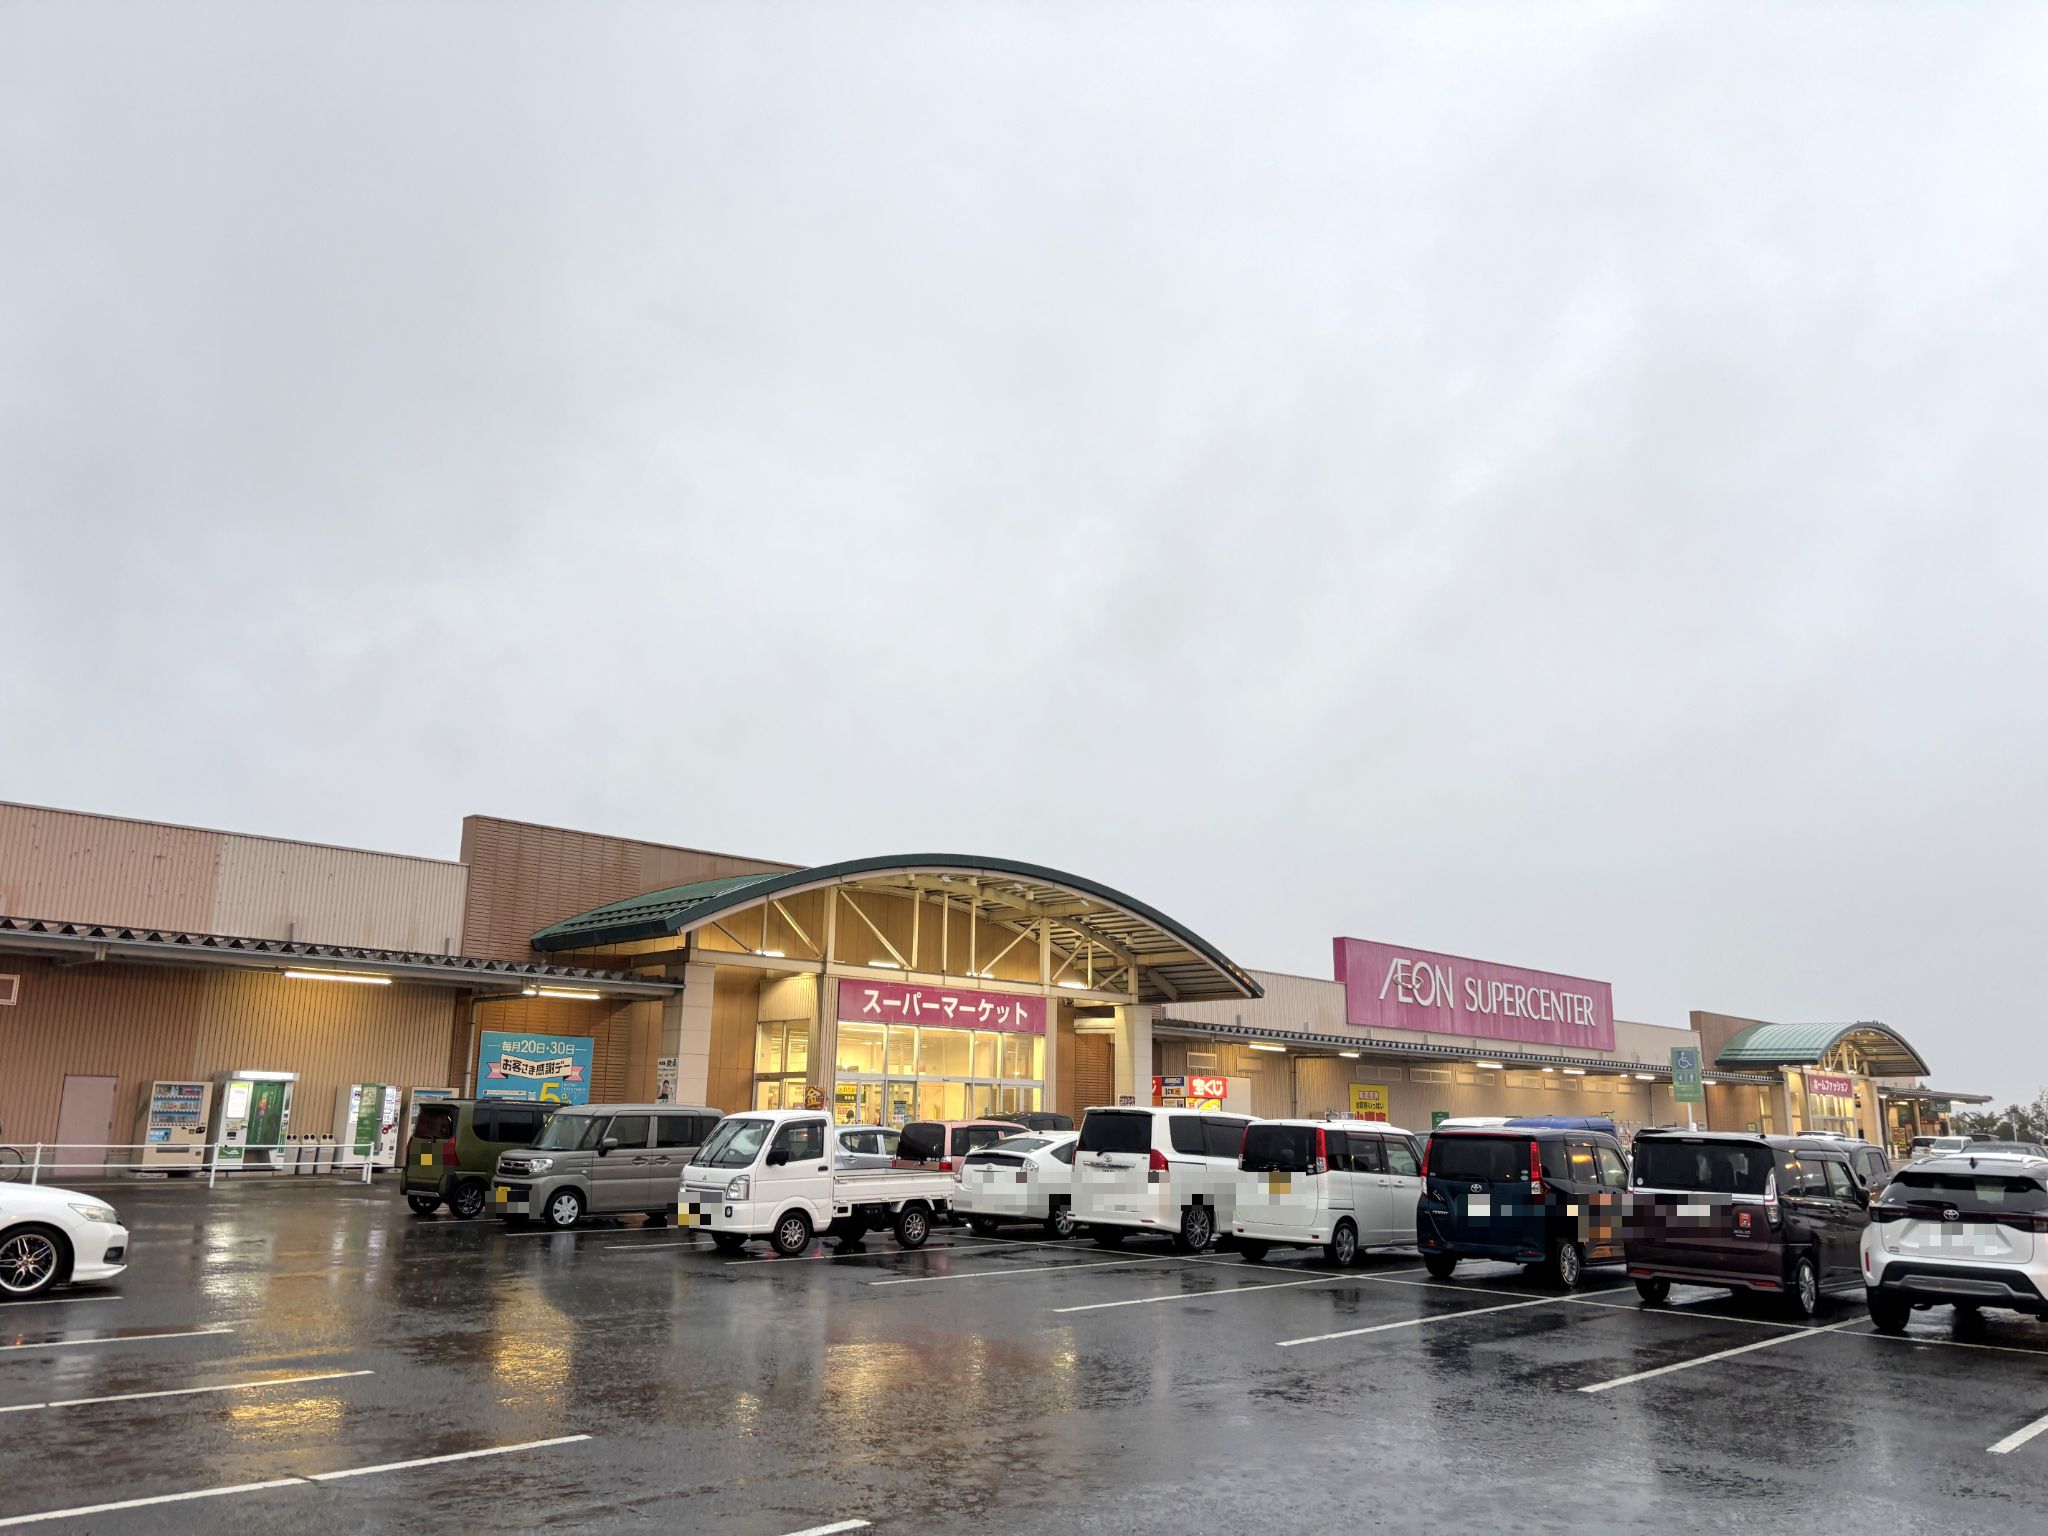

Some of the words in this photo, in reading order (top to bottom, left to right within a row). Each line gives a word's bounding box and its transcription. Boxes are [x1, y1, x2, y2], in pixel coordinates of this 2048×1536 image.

[862, 989, 1028, 1025] スーパーマーケット
[1464, 976, 1596, 1027] SUPERCENTER
[502, 1059, 571, 1076] お客さま感謝デー
[1192, 1078, 1224, 1096] 宝くじ
